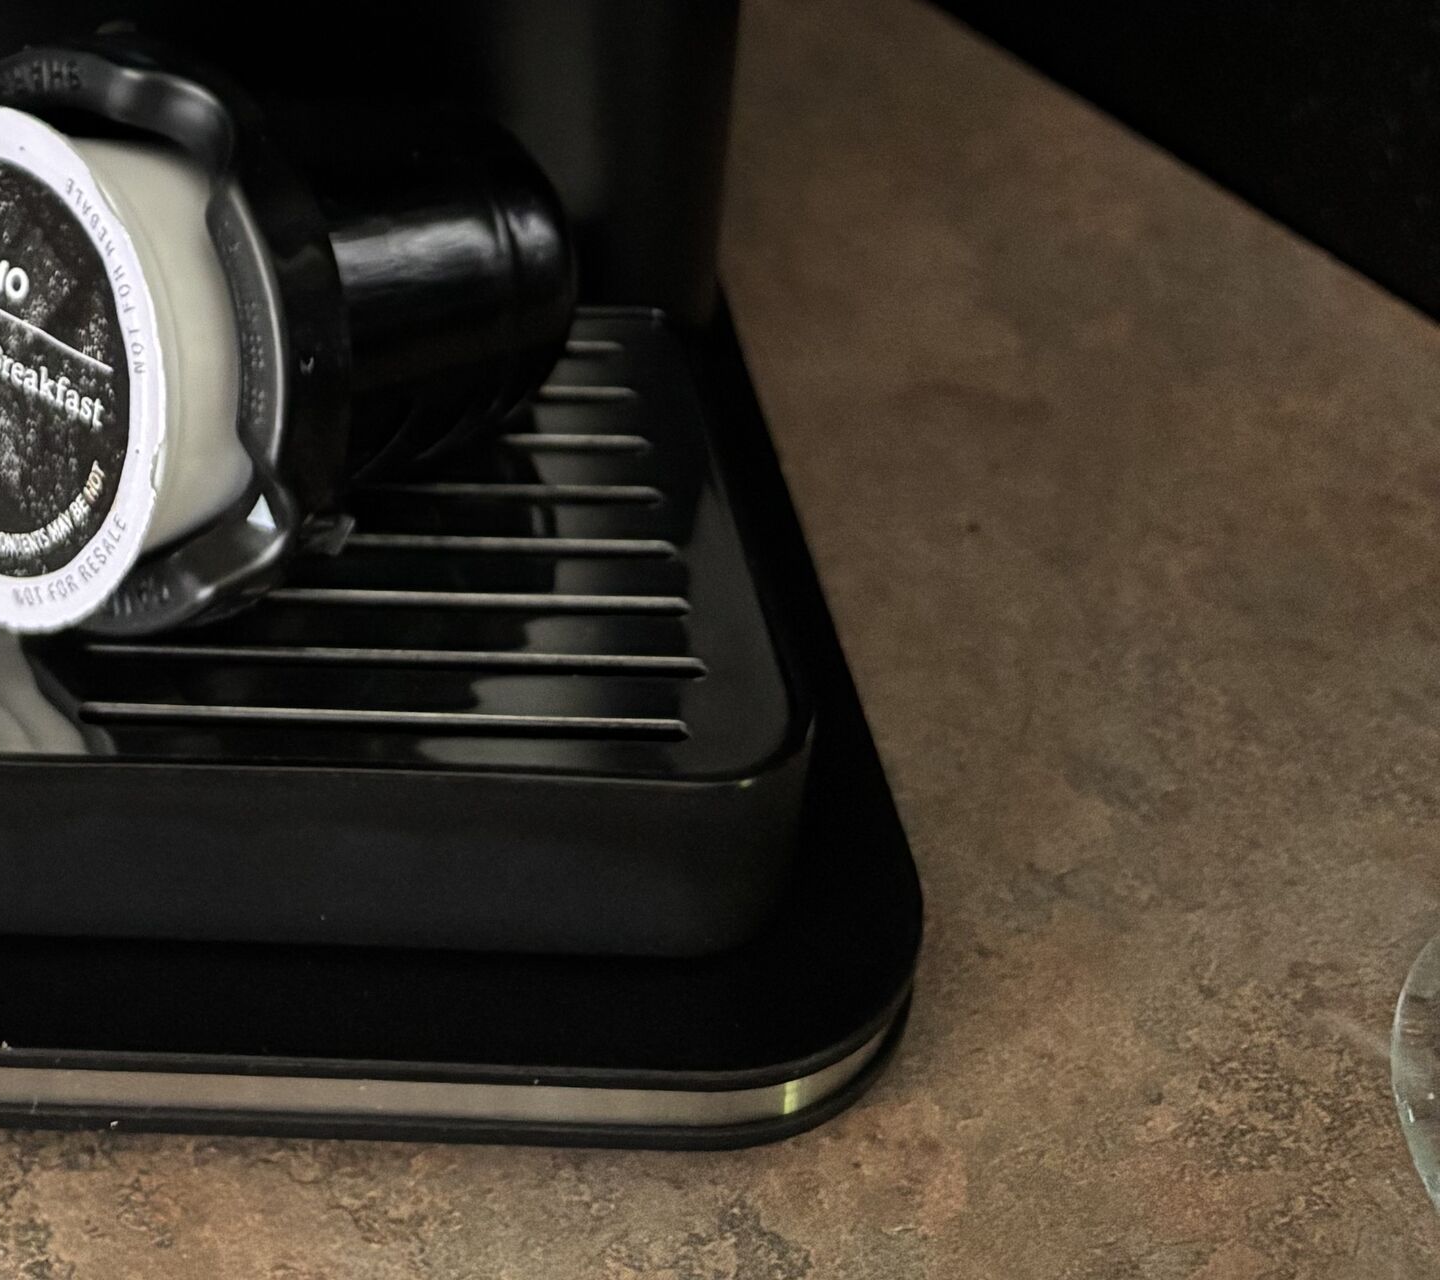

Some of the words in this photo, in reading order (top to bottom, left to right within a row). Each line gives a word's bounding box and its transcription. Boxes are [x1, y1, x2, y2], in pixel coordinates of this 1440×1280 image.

[83, 459, 105, 504] HOT
[48, 574, 79, 602] FOR
[77, 513, 127, 583] RESALE
